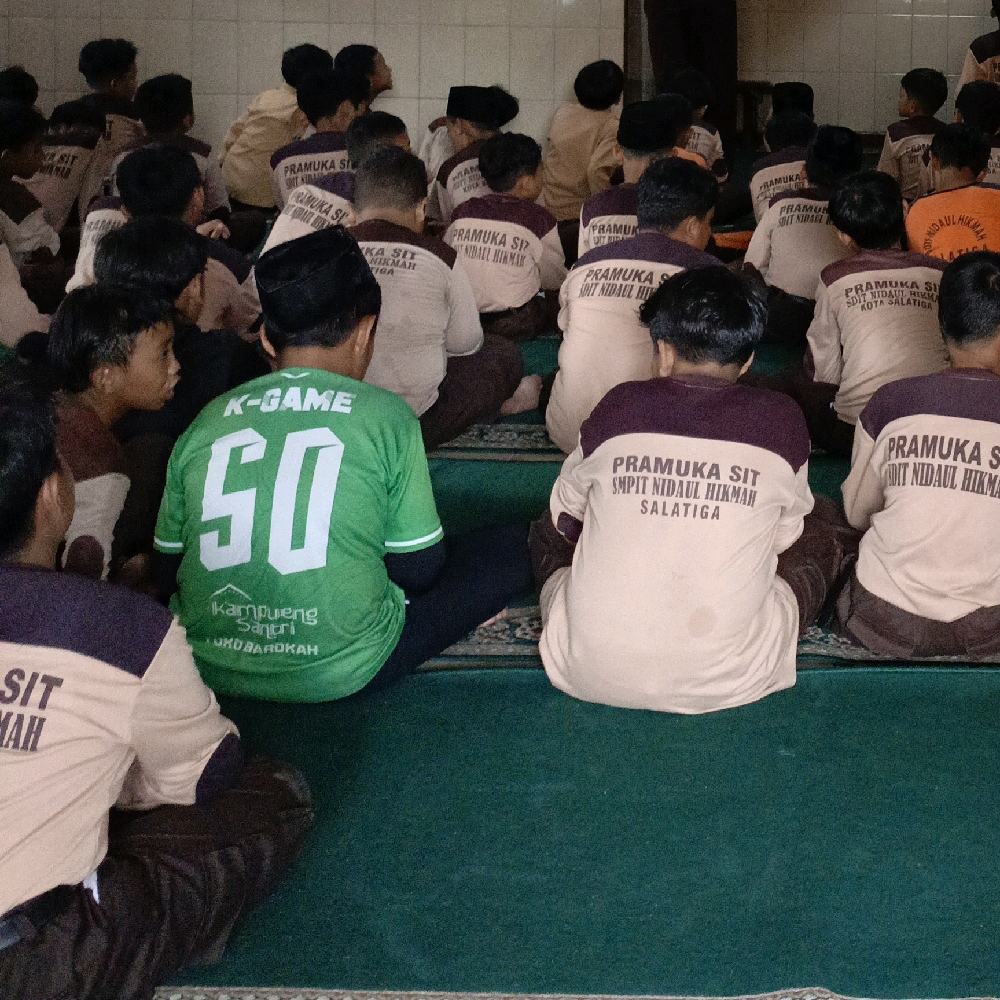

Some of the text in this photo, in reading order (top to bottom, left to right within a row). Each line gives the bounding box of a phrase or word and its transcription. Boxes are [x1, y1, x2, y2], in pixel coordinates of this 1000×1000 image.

[284, 160, 336, 177] PRAMUKA
[453, 229, 507, 248] PRAMUKA
[592, 224, 639, 235] PRAMUK
[391, 247, 416, 260] SIT
[584, 268, 654, 285] PRAMUKA
[598, 283, 634, 299] NIDAUL
[844, 280, 920, 298] PRAMUKA
[846, 293, 867, 308] SDIT
[870, 289, 907, 300] NIDAUL
[860, 298, 933, 311] KOTA SALATIGA
[223, 386, 357, 418] K-GAME
[888, 434, 982, 466] PRAMUKA
[612, 455, 761, 487] PRAMUKA SIT
[911, 462, 958, 490] NIDAUL
[612, 476, 758, 508] SMPIT NIDAUL HIKMAH
[640, 499, 721, 521] SALATIGA
[243, 641, 319, 656] BAROKAH
[0, 667, 64, 711] SIT
